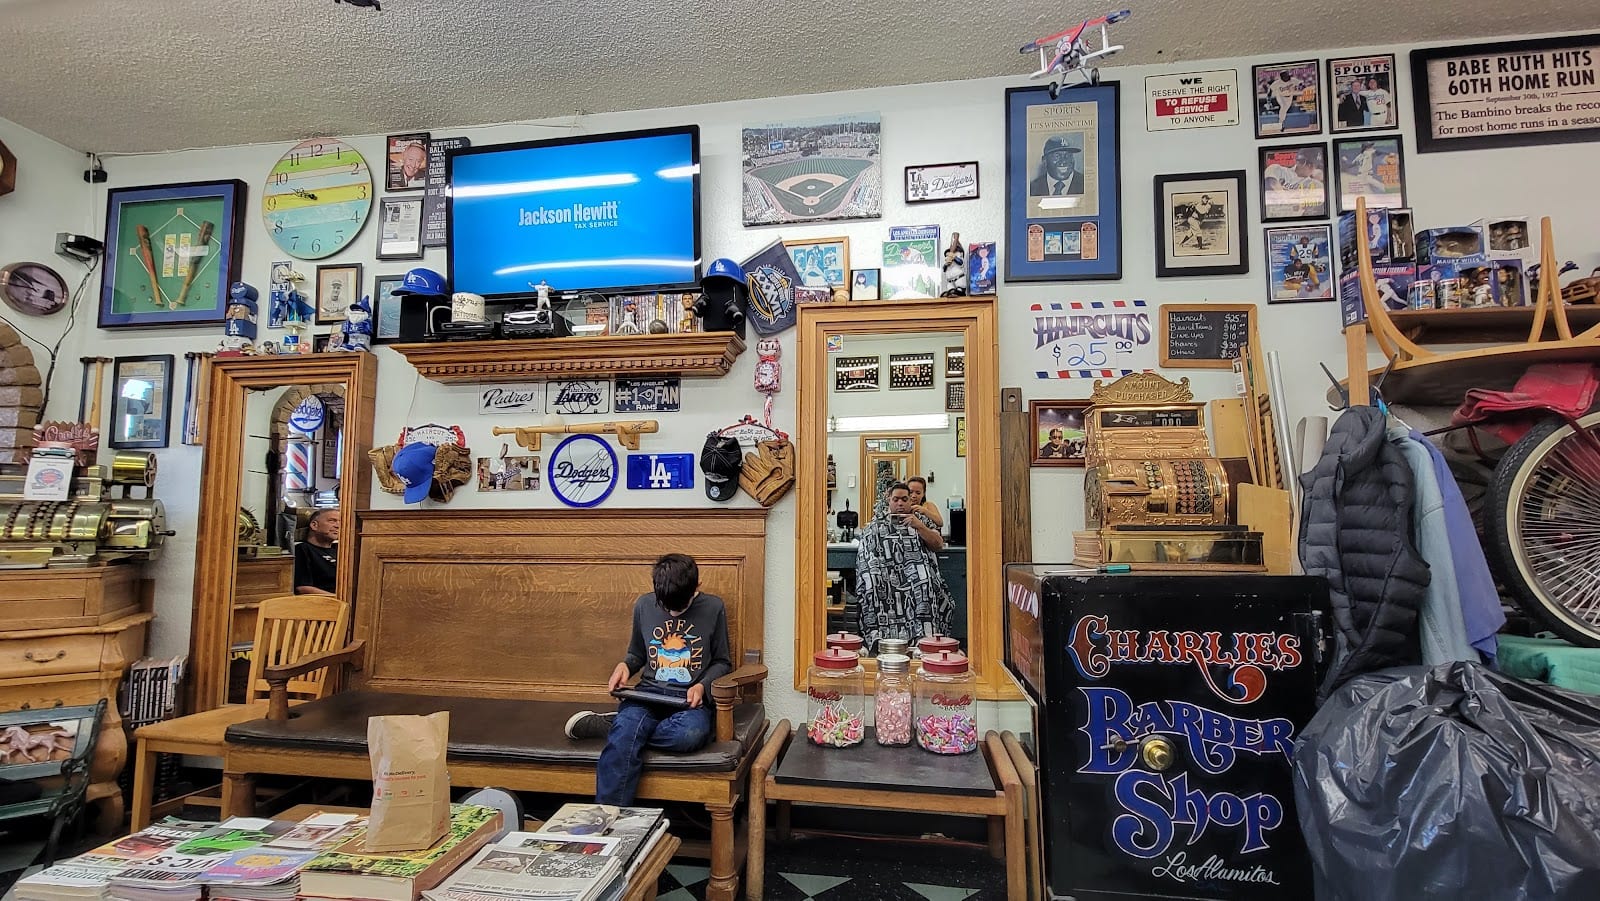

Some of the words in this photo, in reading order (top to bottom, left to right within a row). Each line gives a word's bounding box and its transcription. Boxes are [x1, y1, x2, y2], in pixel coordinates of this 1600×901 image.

[1334, 63, 1391, 76] SPORTS
[1447, 58, 1491, 77] BABE
[1498, 54, 1545, 72] RUTH
[1552, 50, 1592, 68] HITS
[1180, 77, 1203, 85] WE
[1448, 77, 1492, 96] 60TH
[1499, 73, 1550, 91] HOME
[1557, 69, 1595, 87] RUN
[1151, 87, 1187, 97] RESERVE
[1190, 86, 1205, 94] THE
[1207, 84, 1231, 93] RIGHT
[1486, 94, 1521, 103] September
[1523, 93, 1540, 101] 30th,
[1542, 91, 1558, 99] 1927
[1165, 98, 1178, 106] TO
[1181, 95, 1217, 105] REFUSE
[1044, 106, 1081, 115] SPORTS
[1174, 104, 1210, 114] SERVICE
[1436, 111, 1458, 121] The
[1461, 106, 1512, 118] Bambino
[1515, 103, 1552, 115] breaks
[1555, 102, 1573, 112] the
[1576, 101, 1600, 110] reco
[1170, 117, 1181, 125] TO
[1184, 115, 1215, 124] ANYONE
[1438, 125, 1455, 135] for
[1457, 123, 1484, 134] most
[1486, 120, 1518, 132] home
[1520, 119, 1545, 129] runs
[1548, 117, 1559, 127] in
[1561, 118, 1568, 126] a
[1571, 115, 1600, 125] seaso
[310, 144, 323, 157] 12
[290, 153, 300, 166] 11
[350, 162, 359, 175] 2
[276, 172, 288, 185] 10
[931, 173, 974, 194] Dodgers
[358, 185, 367, 200] 3
[267, 198, 276, 211] 9
[350, 210, 360, 223] 4
[518, 206, 571, 226] Jackson
[573, 200, 618, 222] Hewitt
[274, 220, 283, 235] 8
[291, 236, 299, 250] 7
[334, 230, 344, 244] 5
[311, 239, 321, 253] 6
[1033, 313, 1151, 350] HAIRCUTS
[1067, 342, 1108, 366] 25
[1123, 380, 1161, 391] AMOUNT
[483, 388, 536, 409] Padres
[552, 389, 602, 407] LAKERS
[615, 386, 641, 406] #1
[654, 385, 680, 406] FAN
[1115, 389, 1169, 401] PURCHASED
[635, 403, 658, 411] RAMS
[554, 461, 611, 488] Dodgers
[648, 455, 672, 488] LA
[1076, 686, 1295, 774] BARBER
[1112, 768, 1284, 859] Shop
[1152, 851, 1197, 883] Los
[1194, 855, 1281, 885] Alamitos
